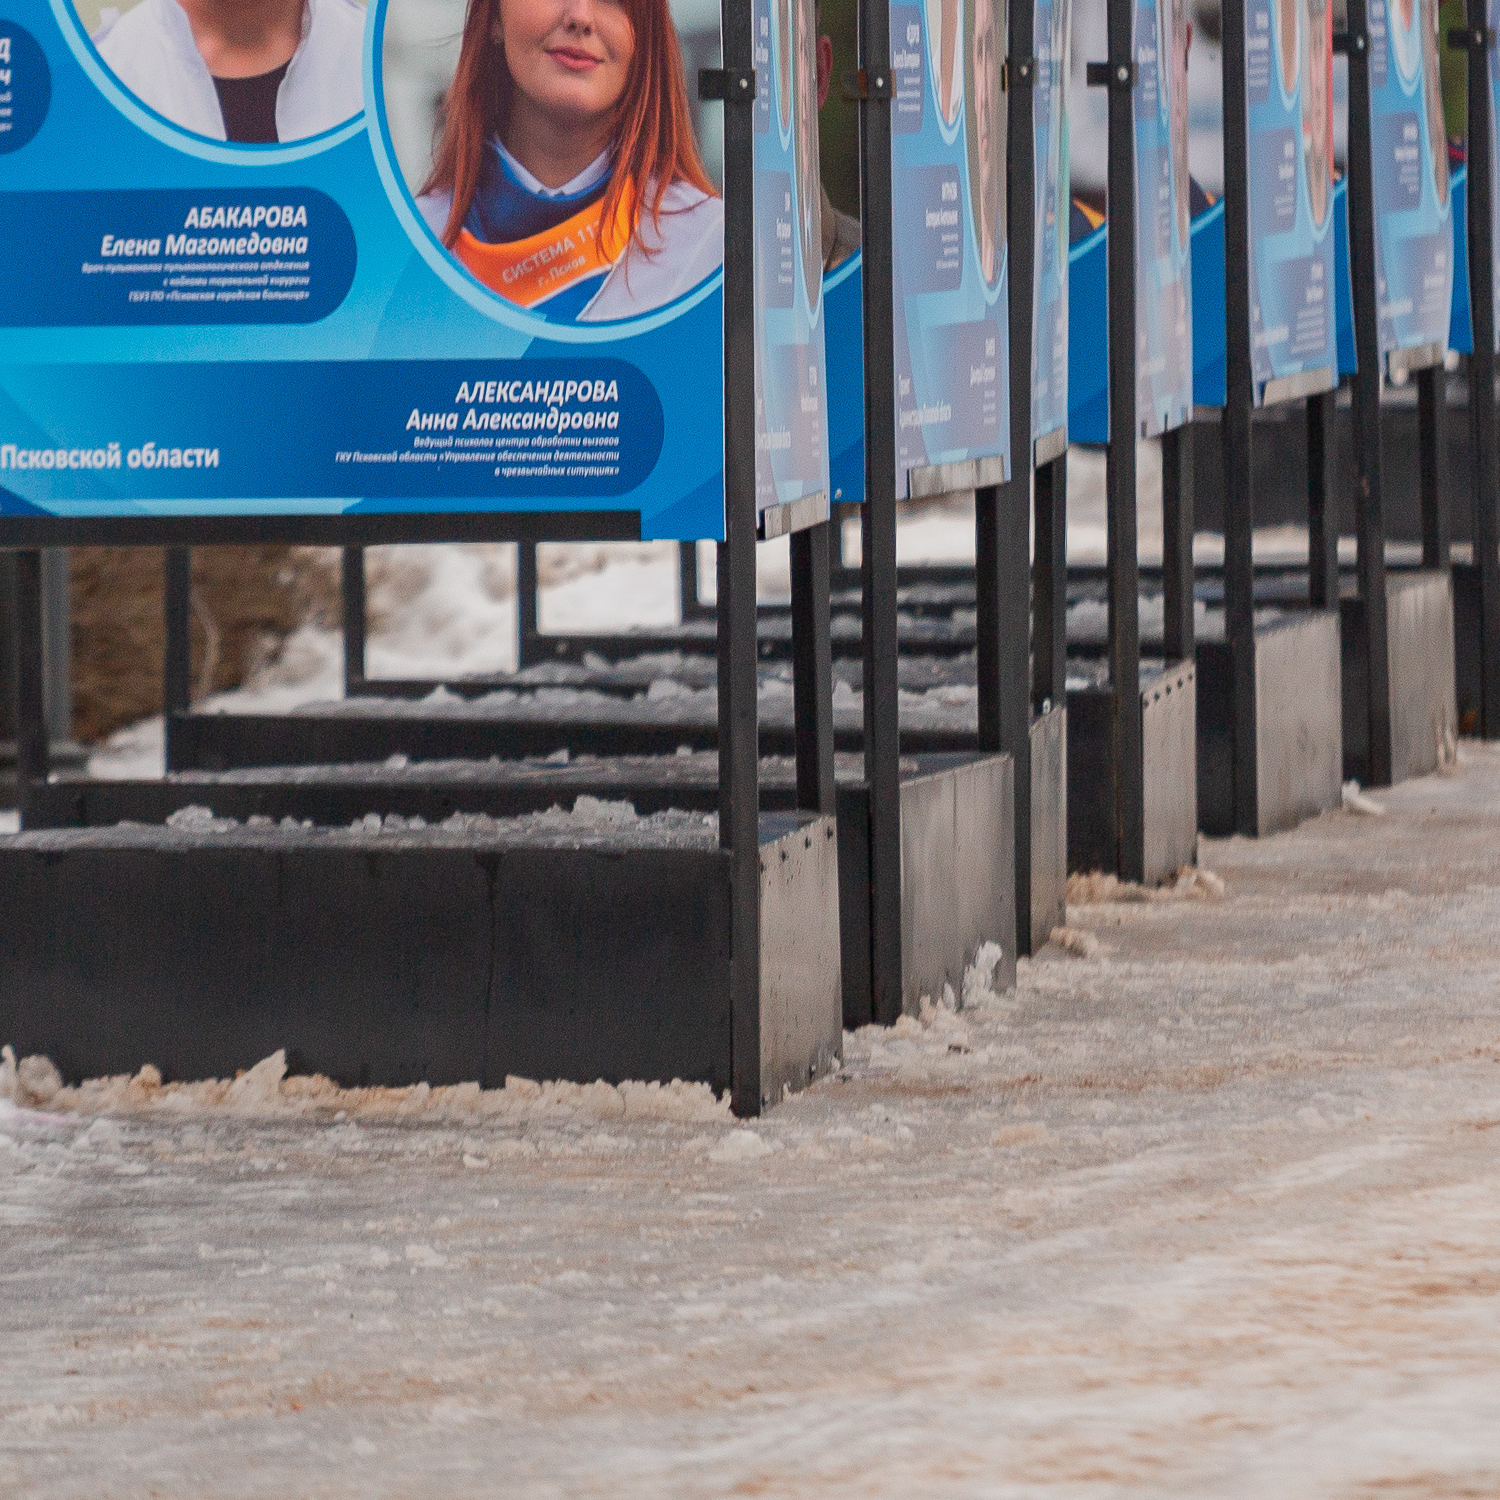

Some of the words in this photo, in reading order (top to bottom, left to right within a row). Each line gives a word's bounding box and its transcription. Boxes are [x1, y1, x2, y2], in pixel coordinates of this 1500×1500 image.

[183, 205, 308, 229] АБАКАРОВА
[100, 234, 162, 257] Елена
[164, 231, 309, 256] Магомедовна
[502, 237, 575, 284] СИСТЕМА
[454, 379, 619, 408] АЛЕКСАНДРОВА
[405, 408, 459, 431] Анна
[462, 406, 620, 435] Александровна
[413, 435, 454, 449] Ведущий
[494, 437, 531, 449] центра
[530, 434, 582, 448] обработки
[0, 442, 122, 470] Псковской
[126, 442, 220, 470] области
